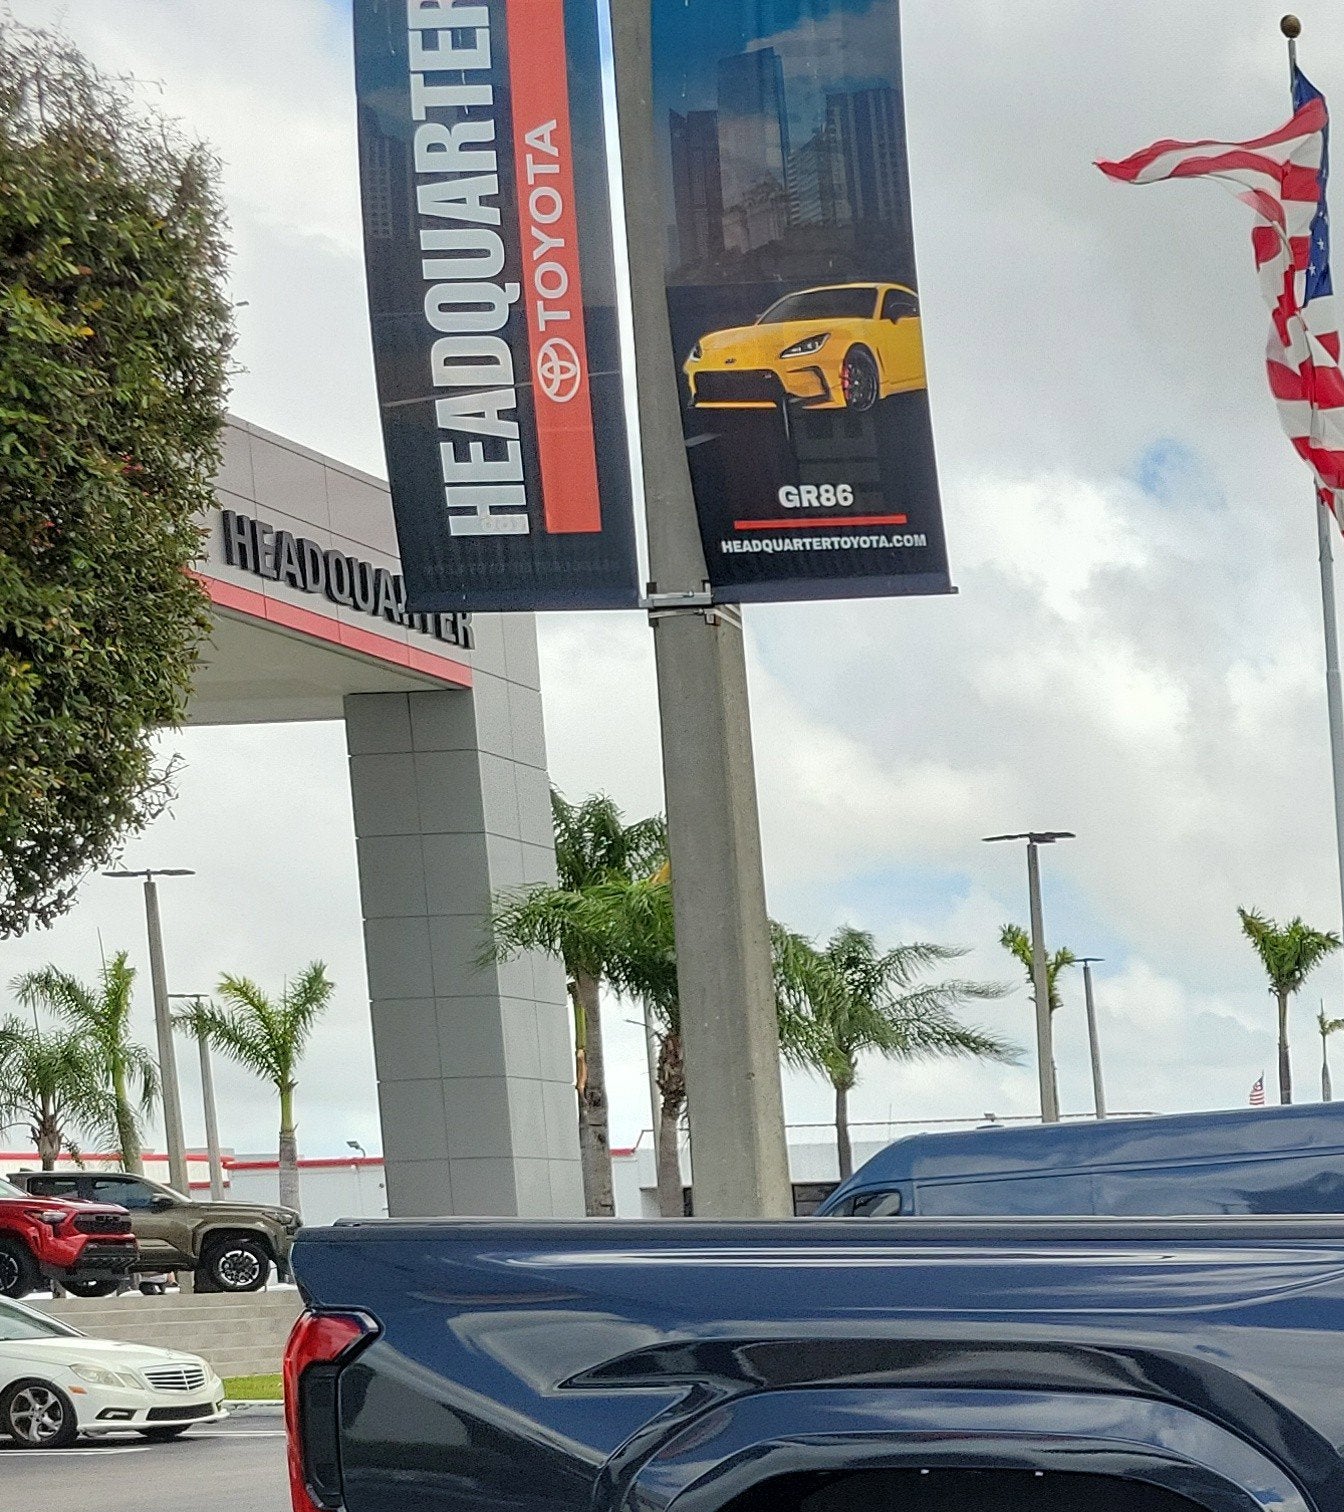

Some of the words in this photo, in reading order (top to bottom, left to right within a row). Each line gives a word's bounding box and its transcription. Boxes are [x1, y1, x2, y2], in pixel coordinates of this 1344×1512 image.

[524, 119, 571, 331] TOYOTA
[778, 484, 854, 508] GR86
[721, 534, 927, 554] HEADQUARTERTOYOTA.COM
